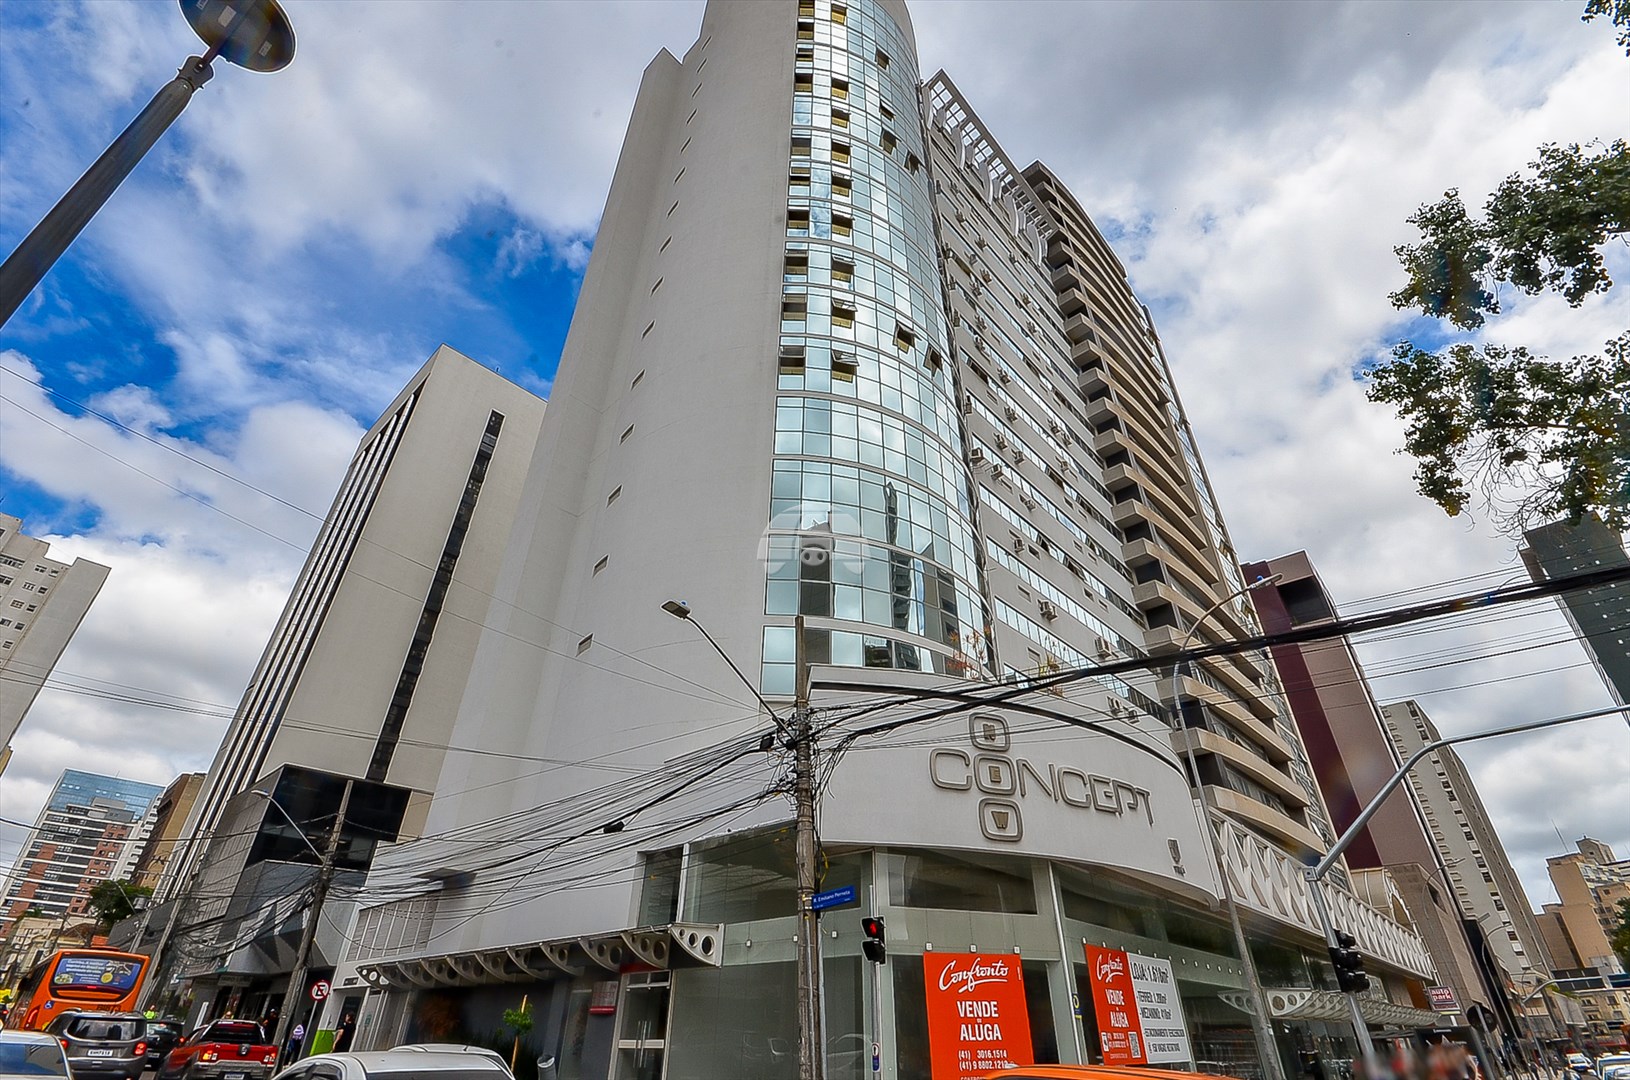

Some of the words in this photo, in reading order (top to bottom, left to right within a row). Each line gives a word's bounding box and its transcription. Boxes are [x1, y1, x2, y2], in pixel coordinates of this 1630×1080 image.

[929, 747, 1154, 826] CONCEPT
[939, 957, 1009, 993] Confronto
[957, 1001, 999, 1018] VENDE
[960, 1024, 1002, 1041] ALUGA
[958, 1050, 971, 1060] (41)
[959, 1060, 972, 1071] (41)
